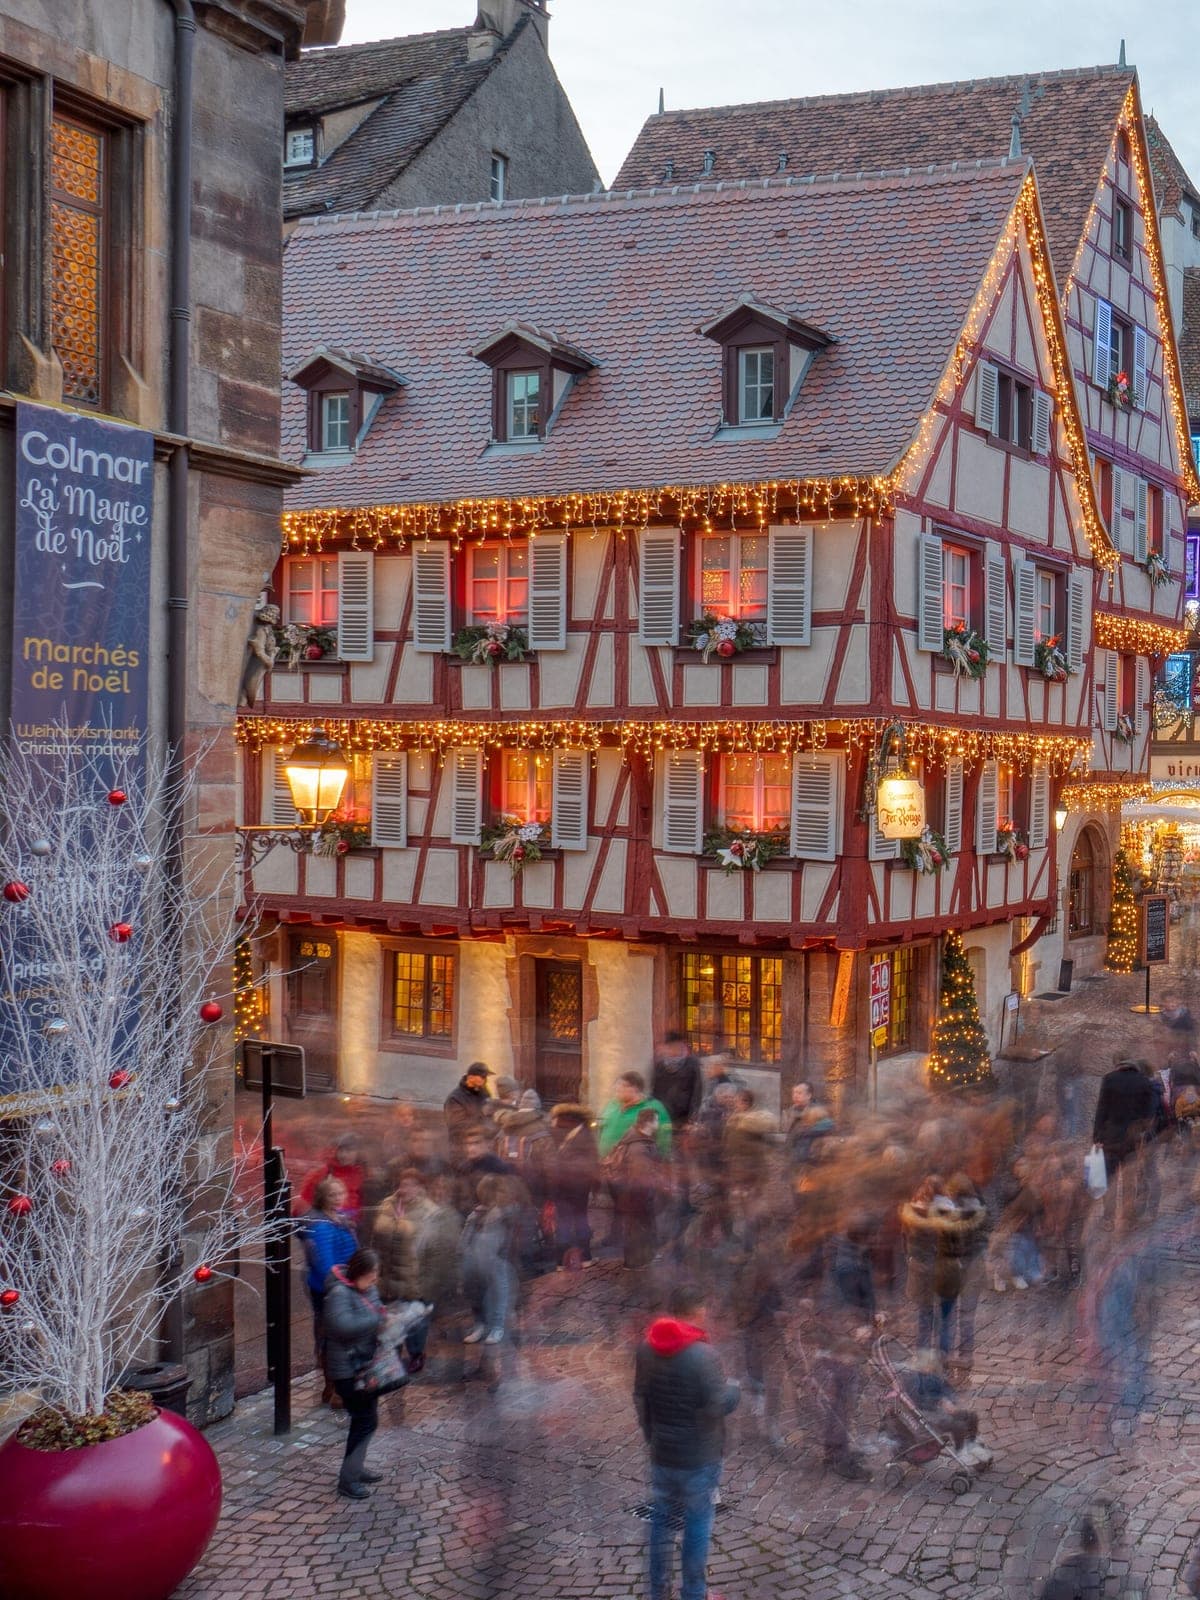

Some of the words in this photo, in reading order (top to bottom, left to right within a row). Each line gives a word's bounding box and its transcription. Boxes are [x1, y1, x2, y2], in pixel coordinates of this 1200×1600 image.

[21, 430, 149, 485] Colmar
[20, 478, 60, 520] La
[64, 485, 149, 533] Magie
[35, 511, 68, 554] de
[71, 527, 132, 566] Noël
[31, 665, 63, 690] de
[17, 723, 141, 741] Weihnachtsmarkt
[19, 741, 84, 756] Christmas
[86, 743, 140, 757] market
